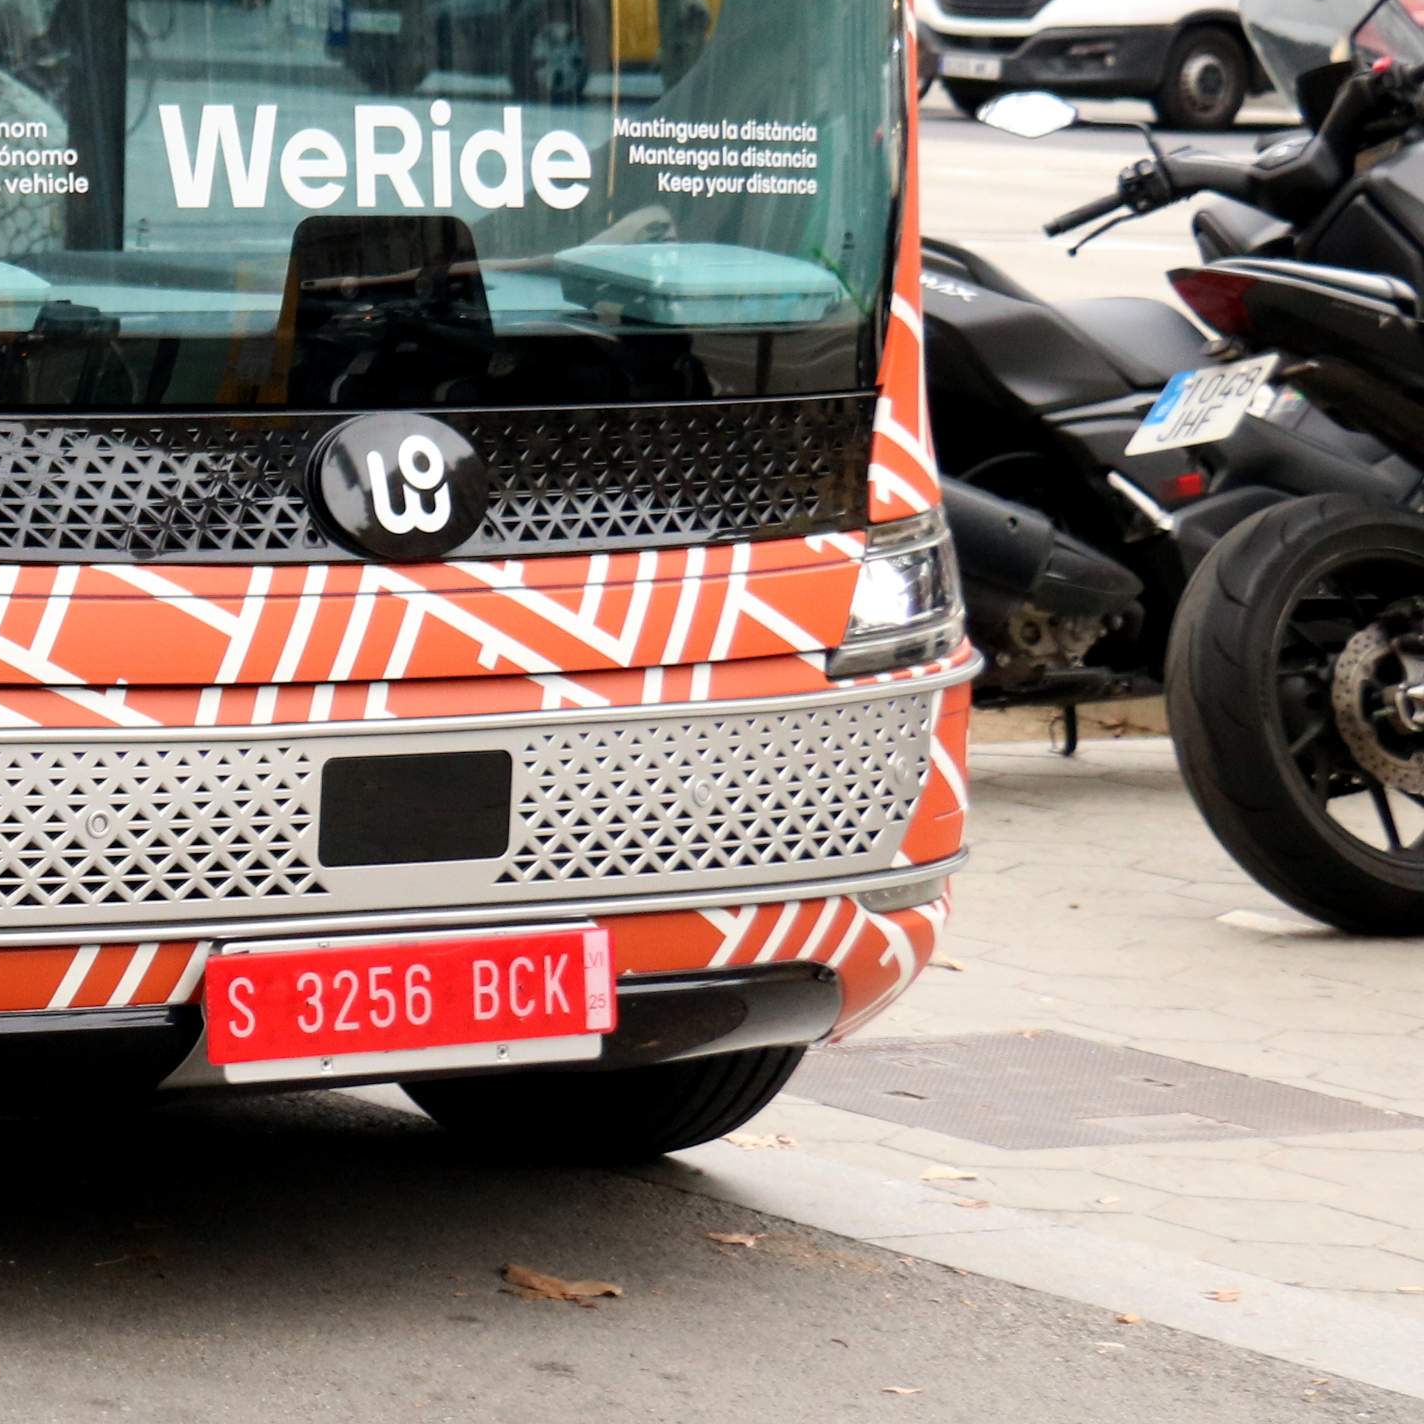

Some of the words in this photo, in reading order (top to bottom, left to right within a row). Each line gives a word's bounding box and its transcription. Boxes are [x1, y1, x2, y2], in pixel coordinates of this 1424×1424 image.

[613, 117, 720, 144] Mantingueu
[722, 119, 738, 140] la
[740, 120, 818, 142] distància
[158, 99, 592, 210] WeRide
[629, 144, 719, 170] Mantenga
[722, 146, 738, 166] la
[740, 147, 818, 168] distancia
[5, 173, 89, 194] vehicle
[658, 172, 704, 197] Keep
[706, 176, 744, 198] your
[746, 173, 818, 195] distance
[1156, 404, 1225, 443] JHF
[227, 976, 256, 1039] S
[296, 963, 433, 1034] 3256
[473, 952, 570, 1021] BCK
[588, 993, 607, 1010] 25
